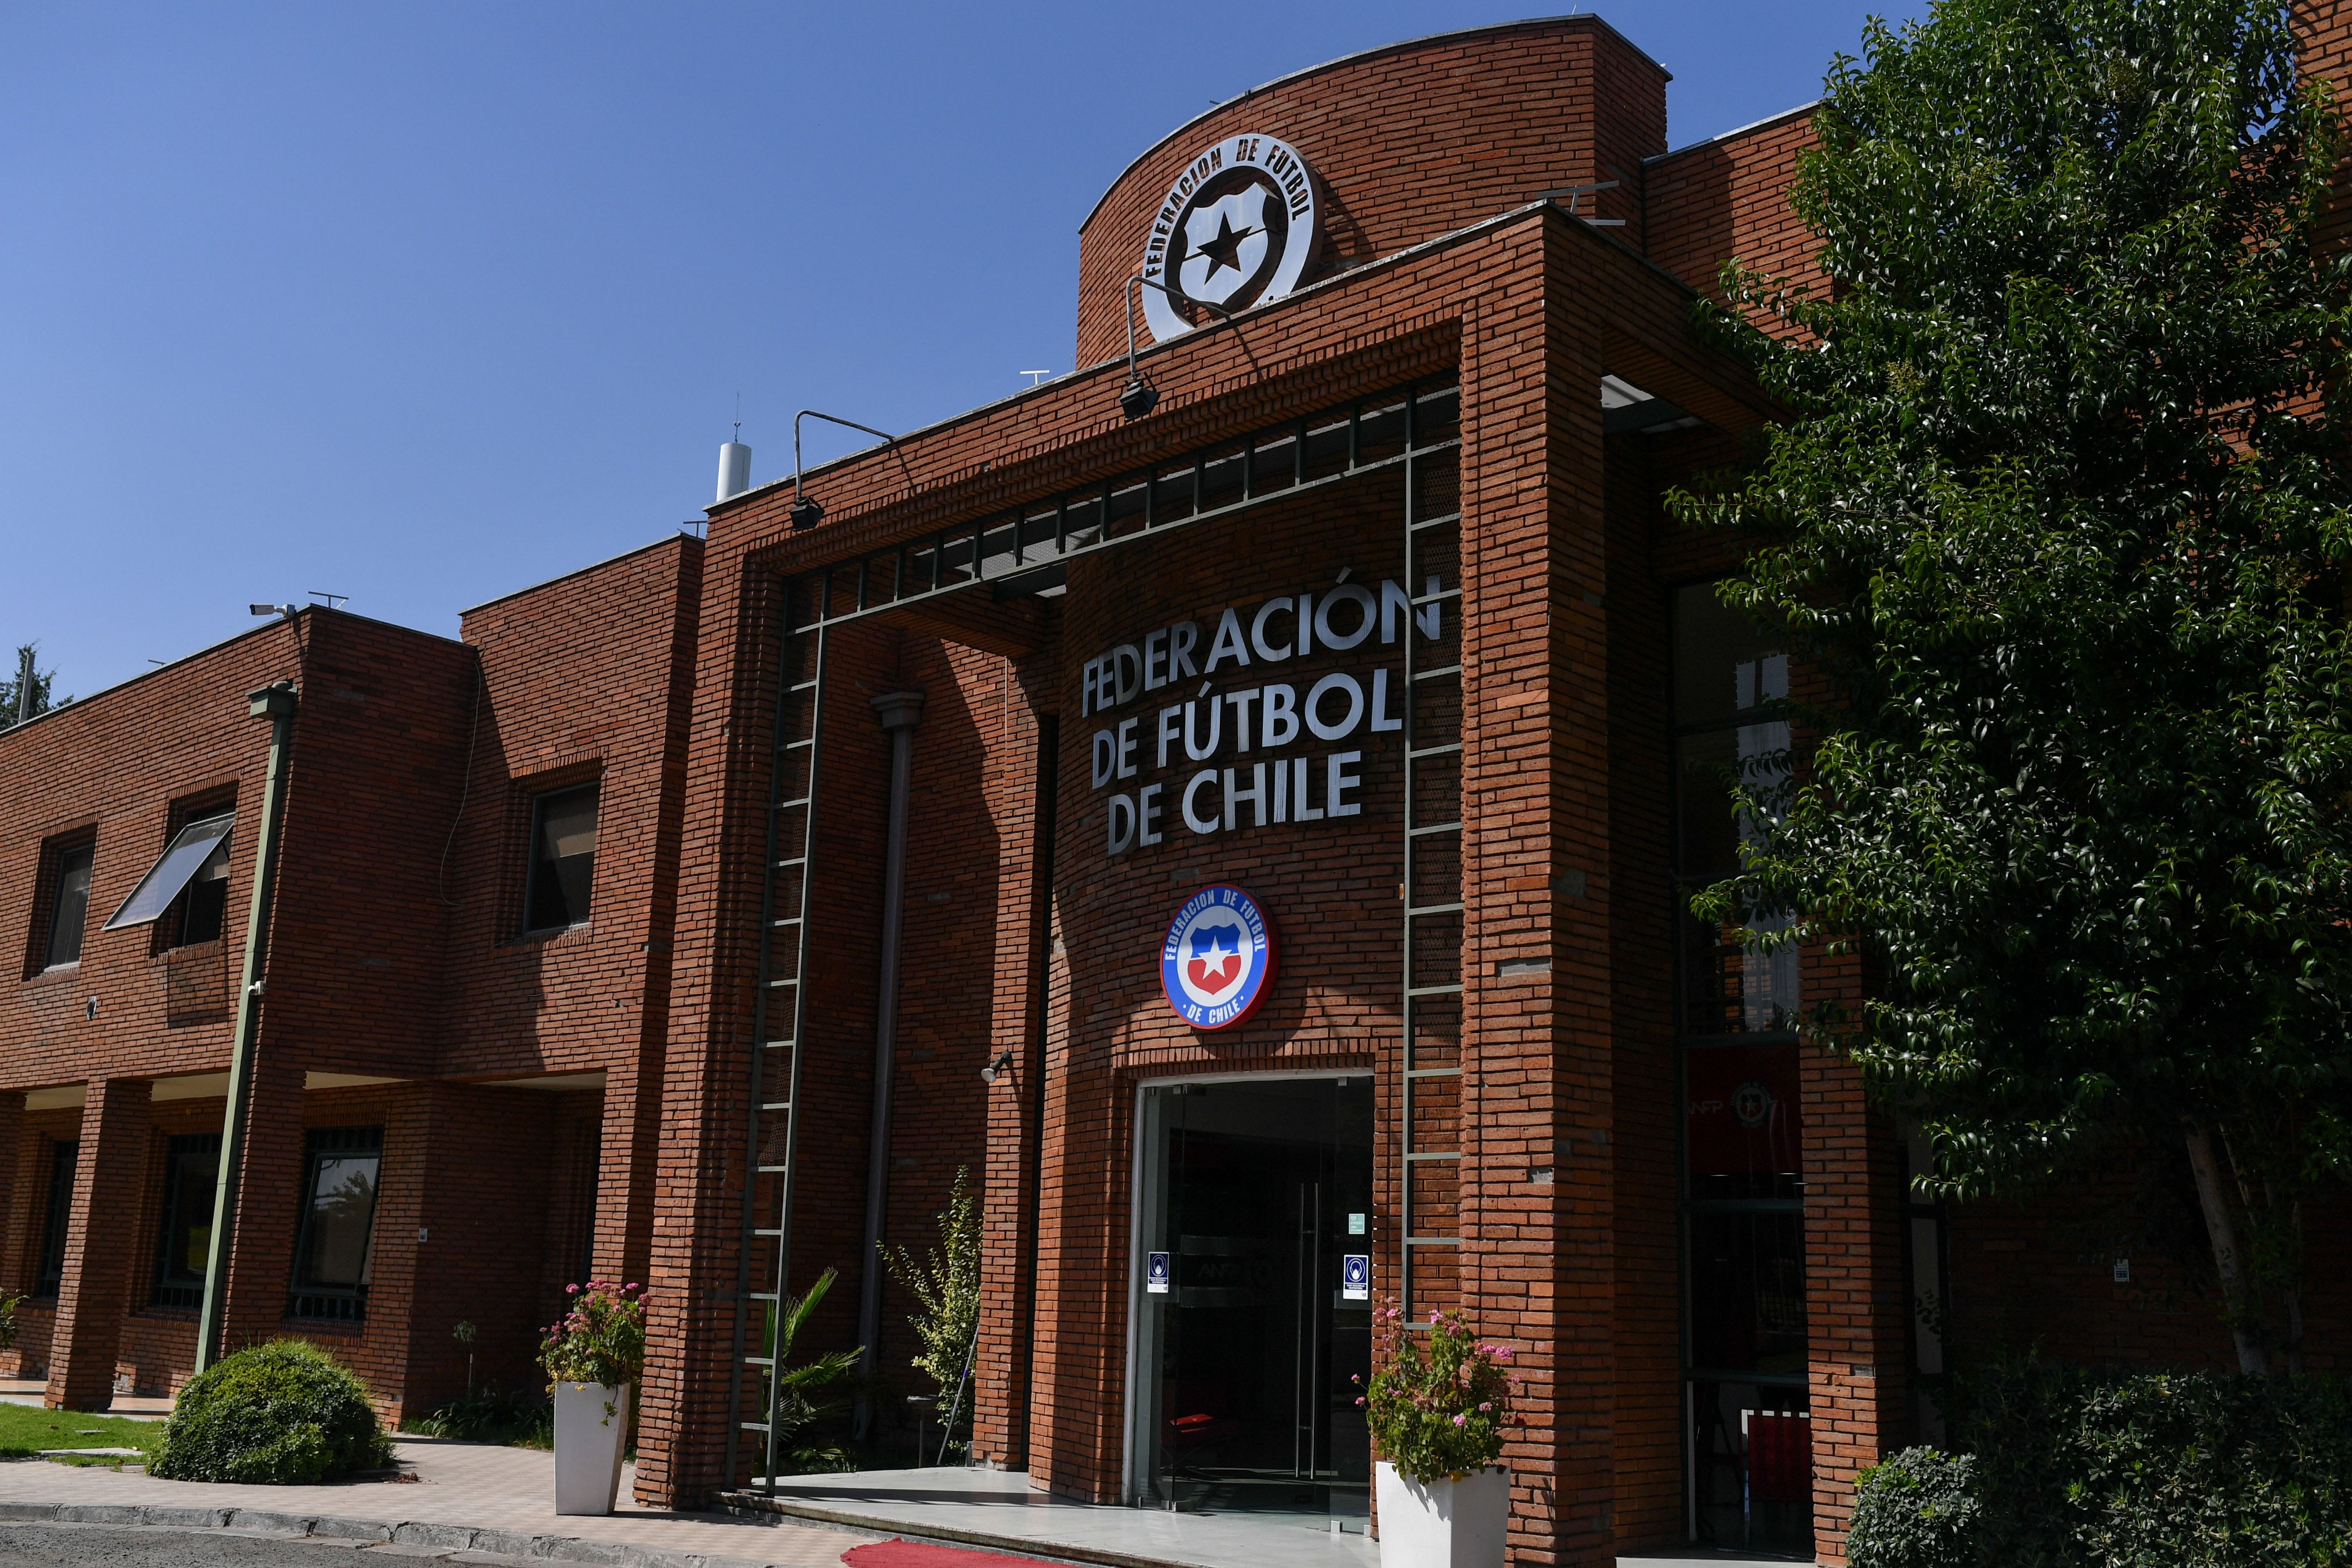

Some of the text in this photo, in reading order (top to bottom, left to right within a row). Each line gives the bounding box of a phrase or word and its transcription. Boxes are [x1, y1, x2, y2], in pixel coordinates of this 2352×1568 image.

[1145, 138, 1310, 278] FEDERACION DE FUTBOL
[1082, 566, 1441, 718] FEDERACIÓN
[1092, 667, 1402, 790] DE FÚTBOL
[1107, 750, 1361, 856] DE CHILE
[1165, 889, 1266, 960] FEDERACION DE FUTBOL
[1186, 998, 1241, 1024] DE CHILE
